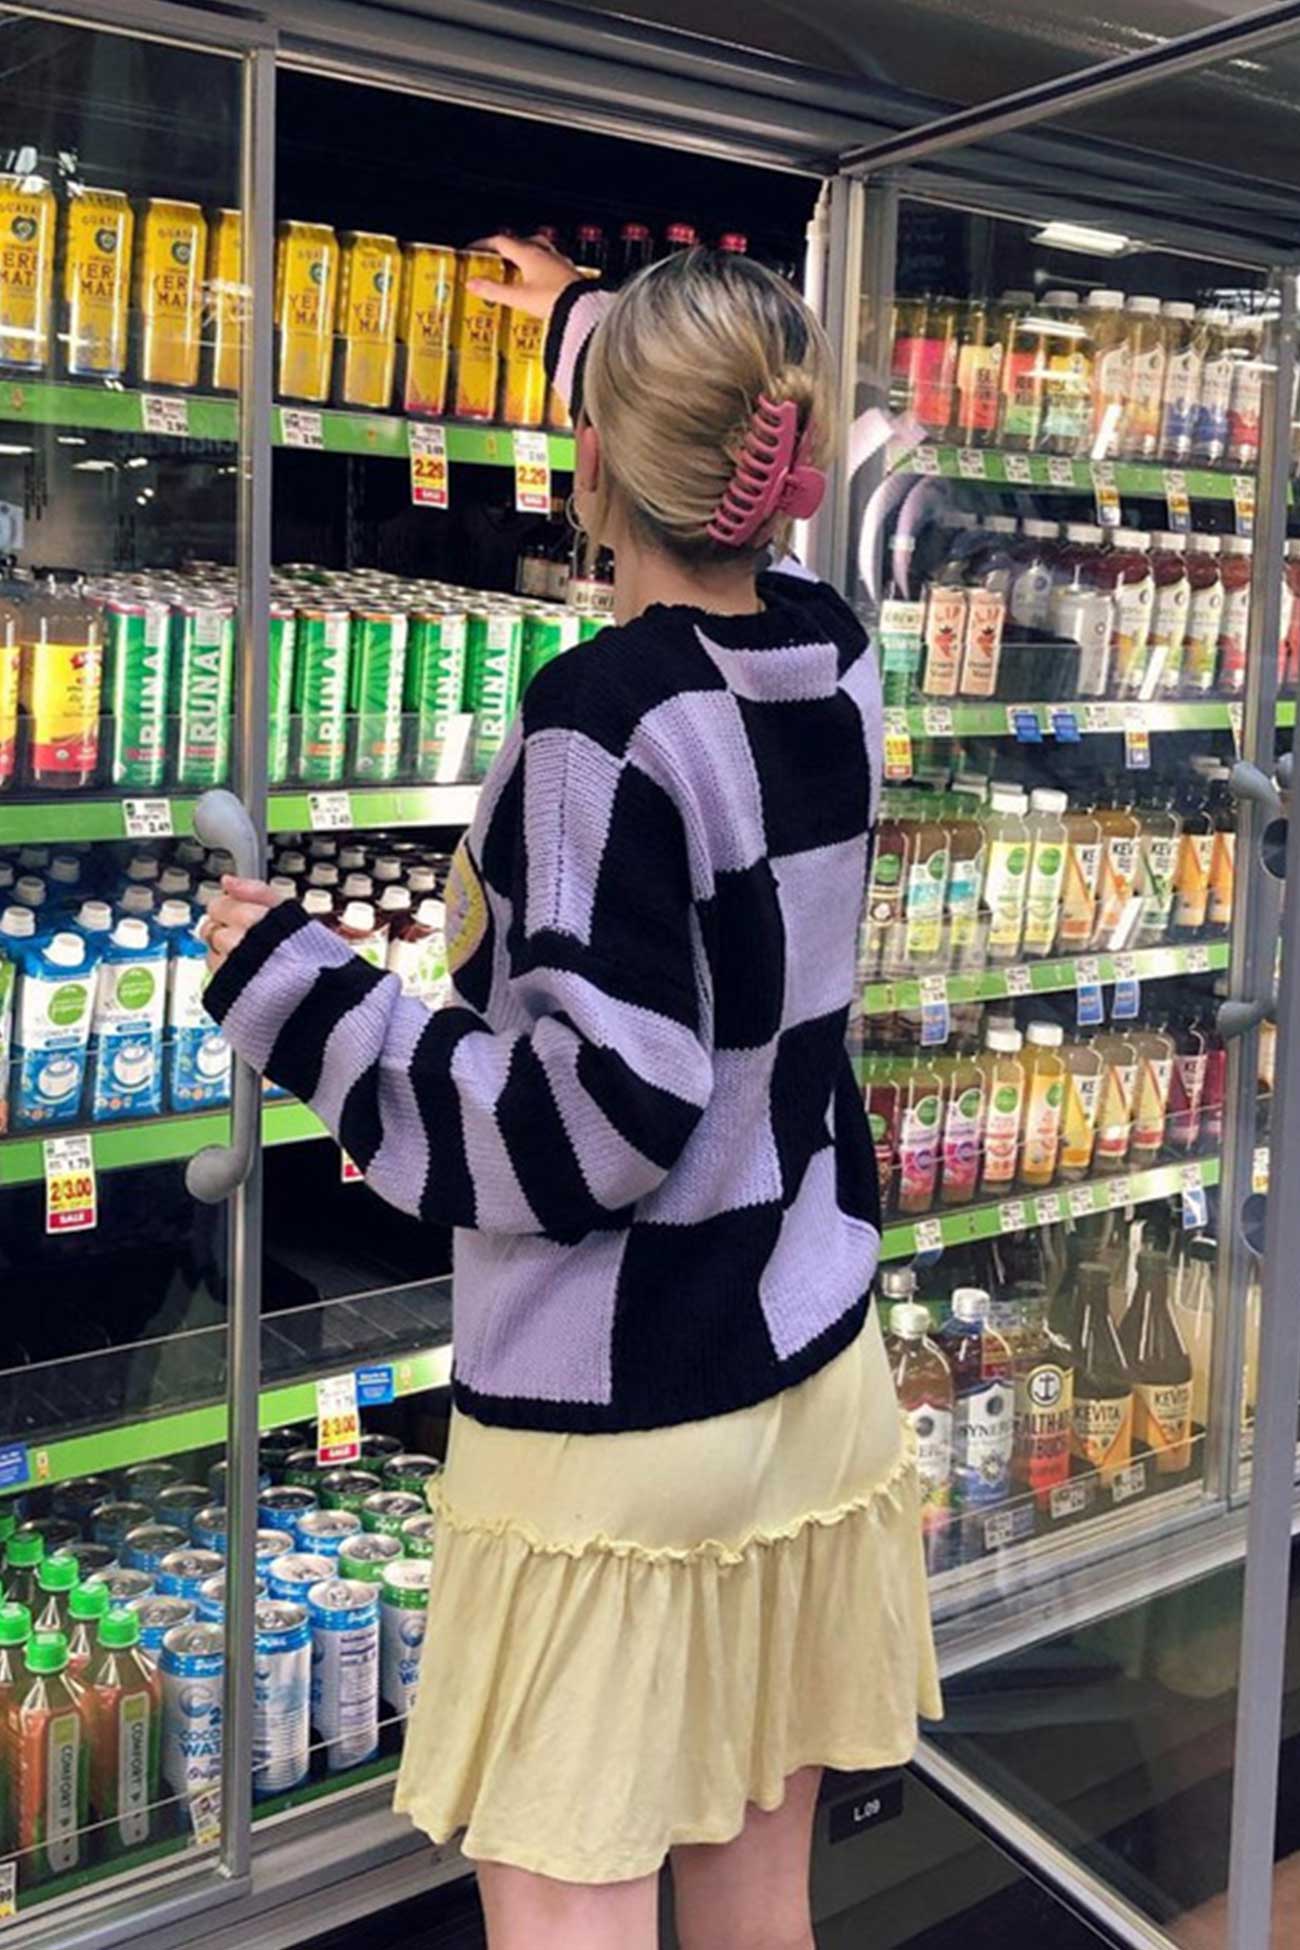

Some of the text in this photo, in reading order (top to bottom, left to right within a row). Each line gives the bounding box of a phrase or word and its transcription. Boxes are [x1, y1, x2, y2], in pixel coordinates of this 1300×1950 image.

[414, 458, 444, 479] 2.29
[518, 466, 546, 484] 2.29
[139, 651, 160, 744] RUNA
[189, 652, 221, 745] RUNA
[319, 650, 344, 739] RUNA
[481, 649, 507, 737] RUNA
[1075, 1404, 1120, 1423] KEVITA
[60, 1744, 74, 1809] COMFORT
[131, 1722, 144, 1784] COMFORT
